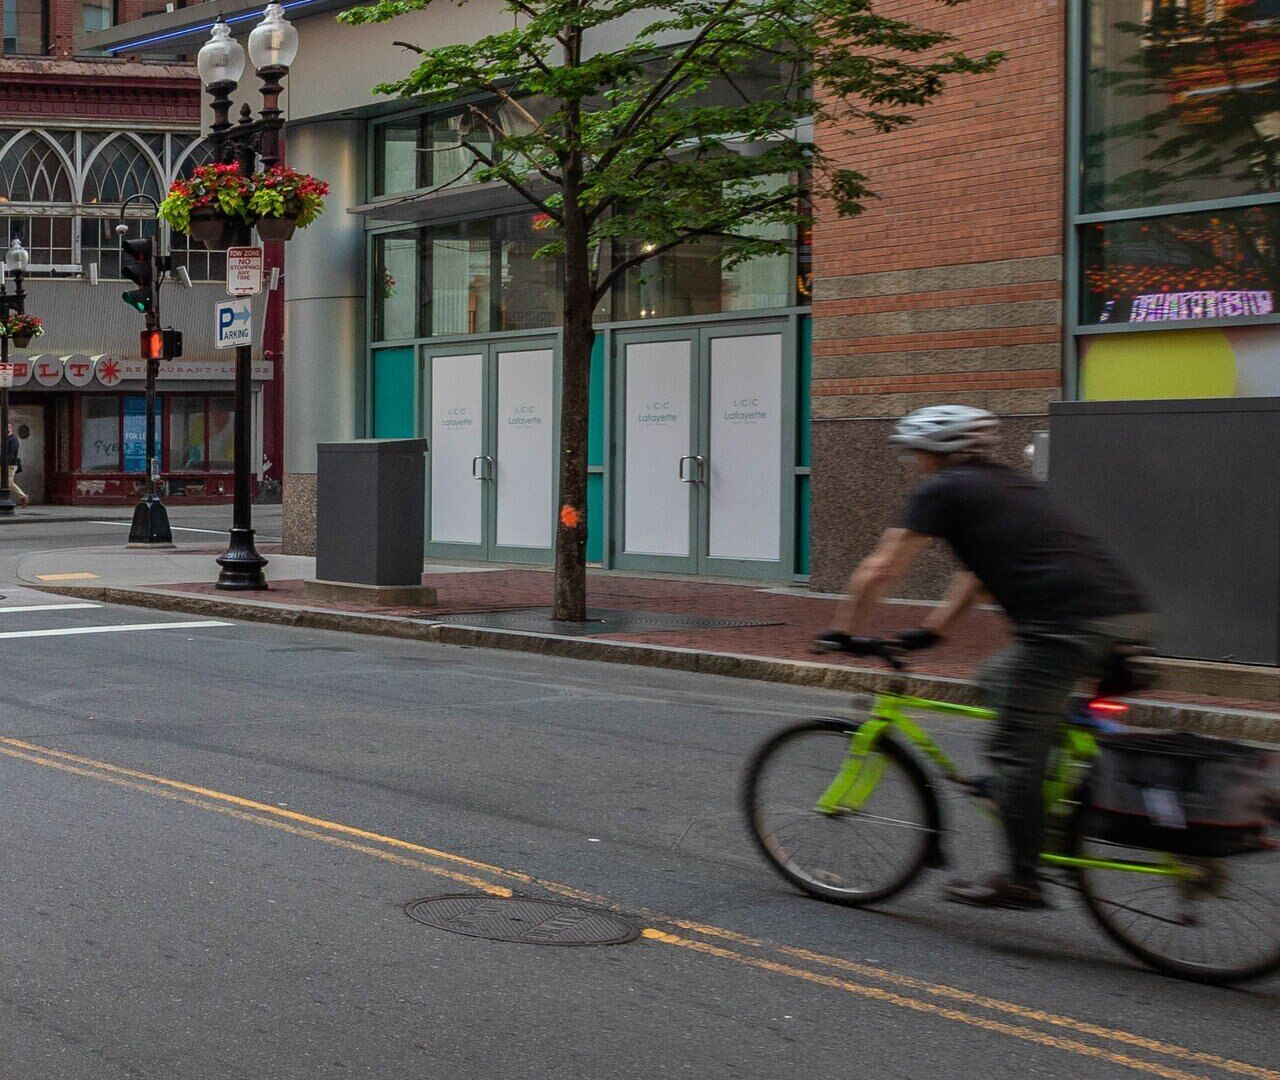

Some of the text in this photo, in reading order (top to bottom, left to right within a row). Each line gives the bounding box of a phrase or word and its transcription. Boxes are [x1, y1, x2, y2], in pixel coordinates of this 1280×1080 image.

[221, 366, 270, 374] LOGE
[638, 413, 678, 422] Lafayette
[724, 410, 768, 420] Lafayette
[441, 418, 472, 426] Lafayette
[508, 416, 543, 425] Lafayette
[125, 432, 139, 440] FOR
